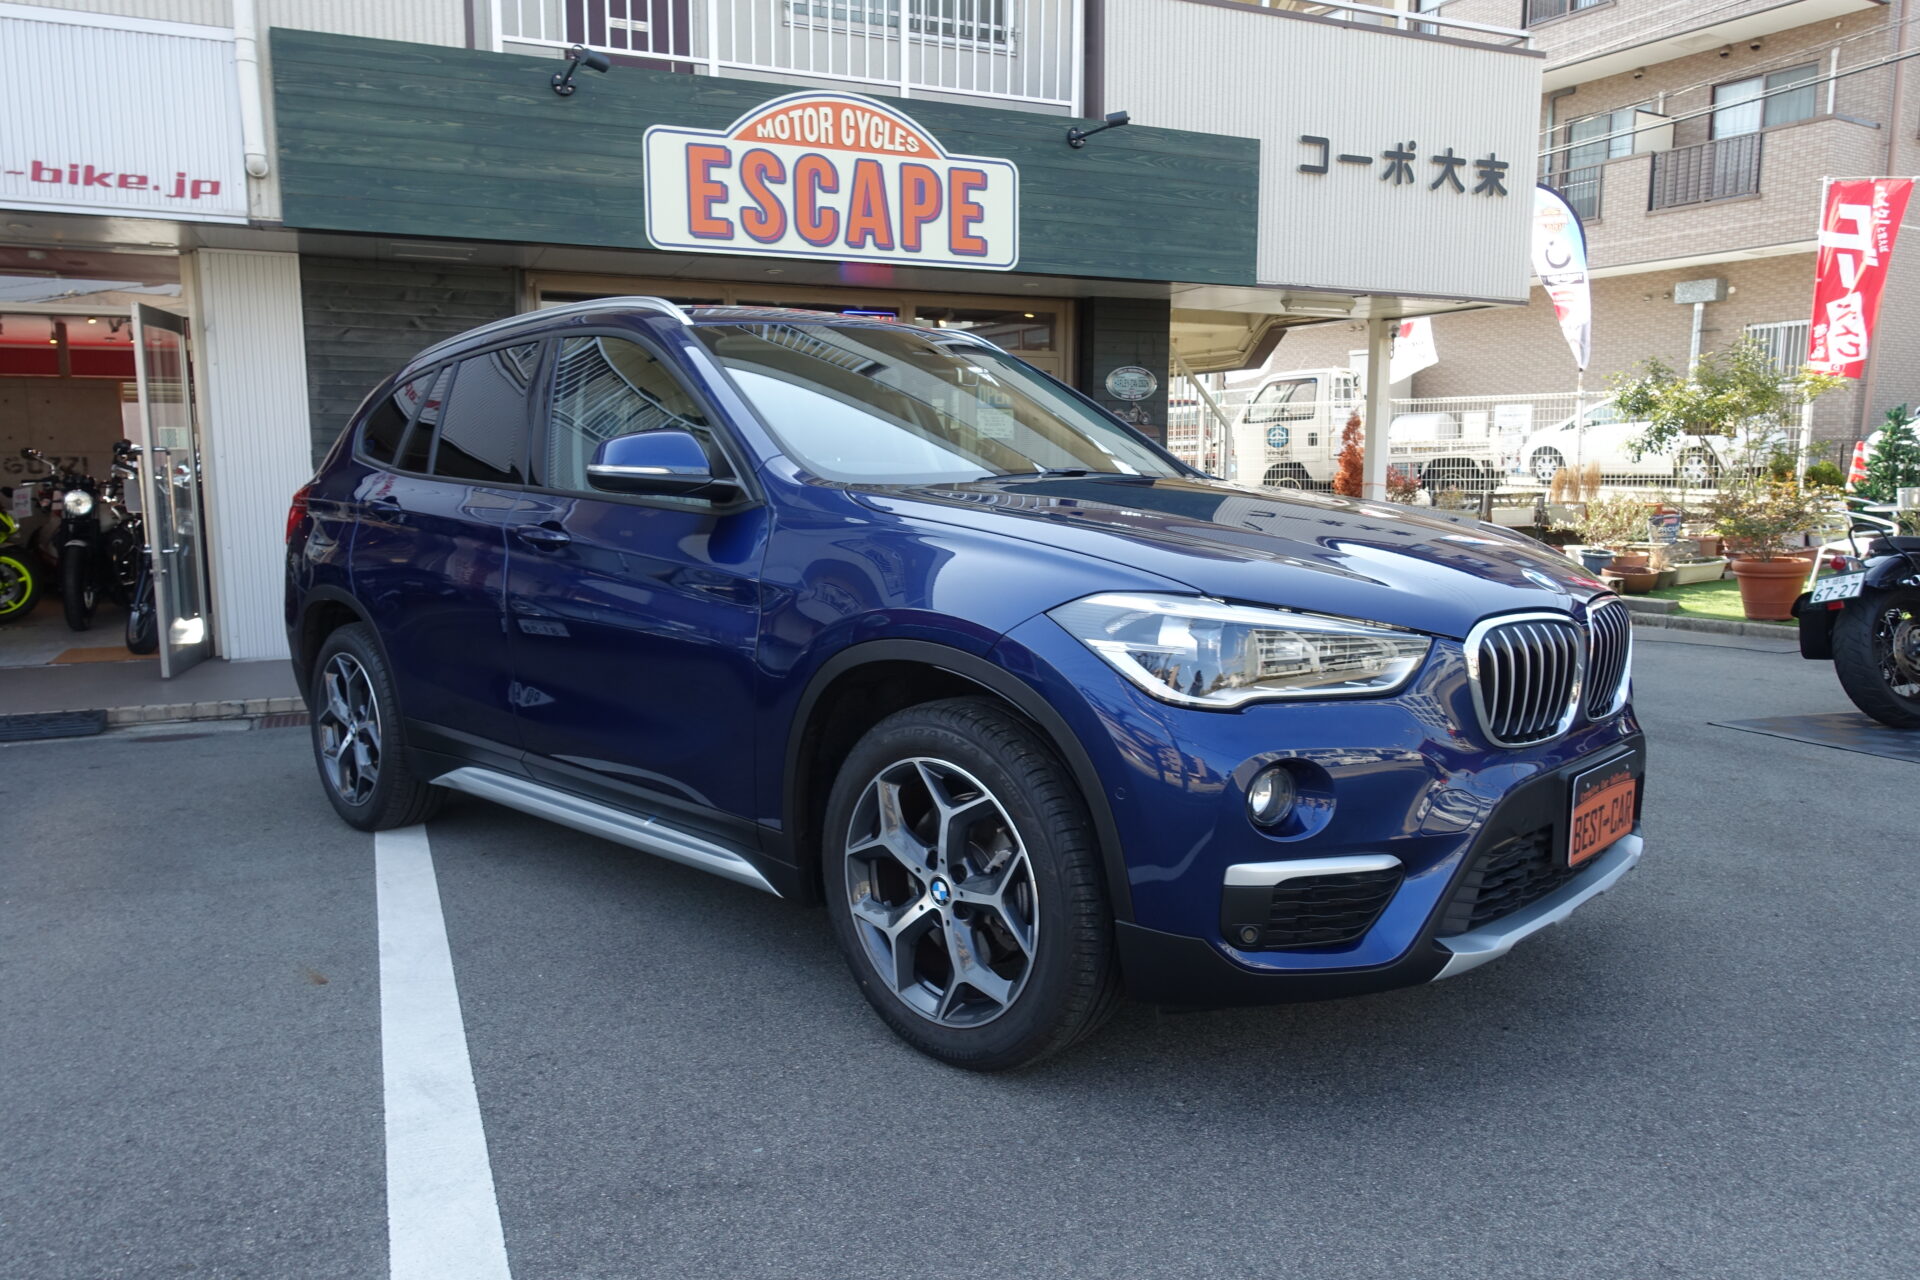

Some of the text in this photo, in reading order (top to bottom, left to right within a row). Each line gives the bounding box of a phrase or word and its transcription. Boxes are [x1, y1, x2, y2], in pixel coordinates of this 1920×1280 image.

[756, 106, 920, 153] MOTOR CYCLES
[0, 160, 220, 199] -bike.jp
[1298, 134, 1510, 197] コーポ大末
[686, 142, 988, 257] ESCAPE
[1814, 583, 1859, 601] 67-27
[1573, 790, 1633, 855] BEST-CAR
